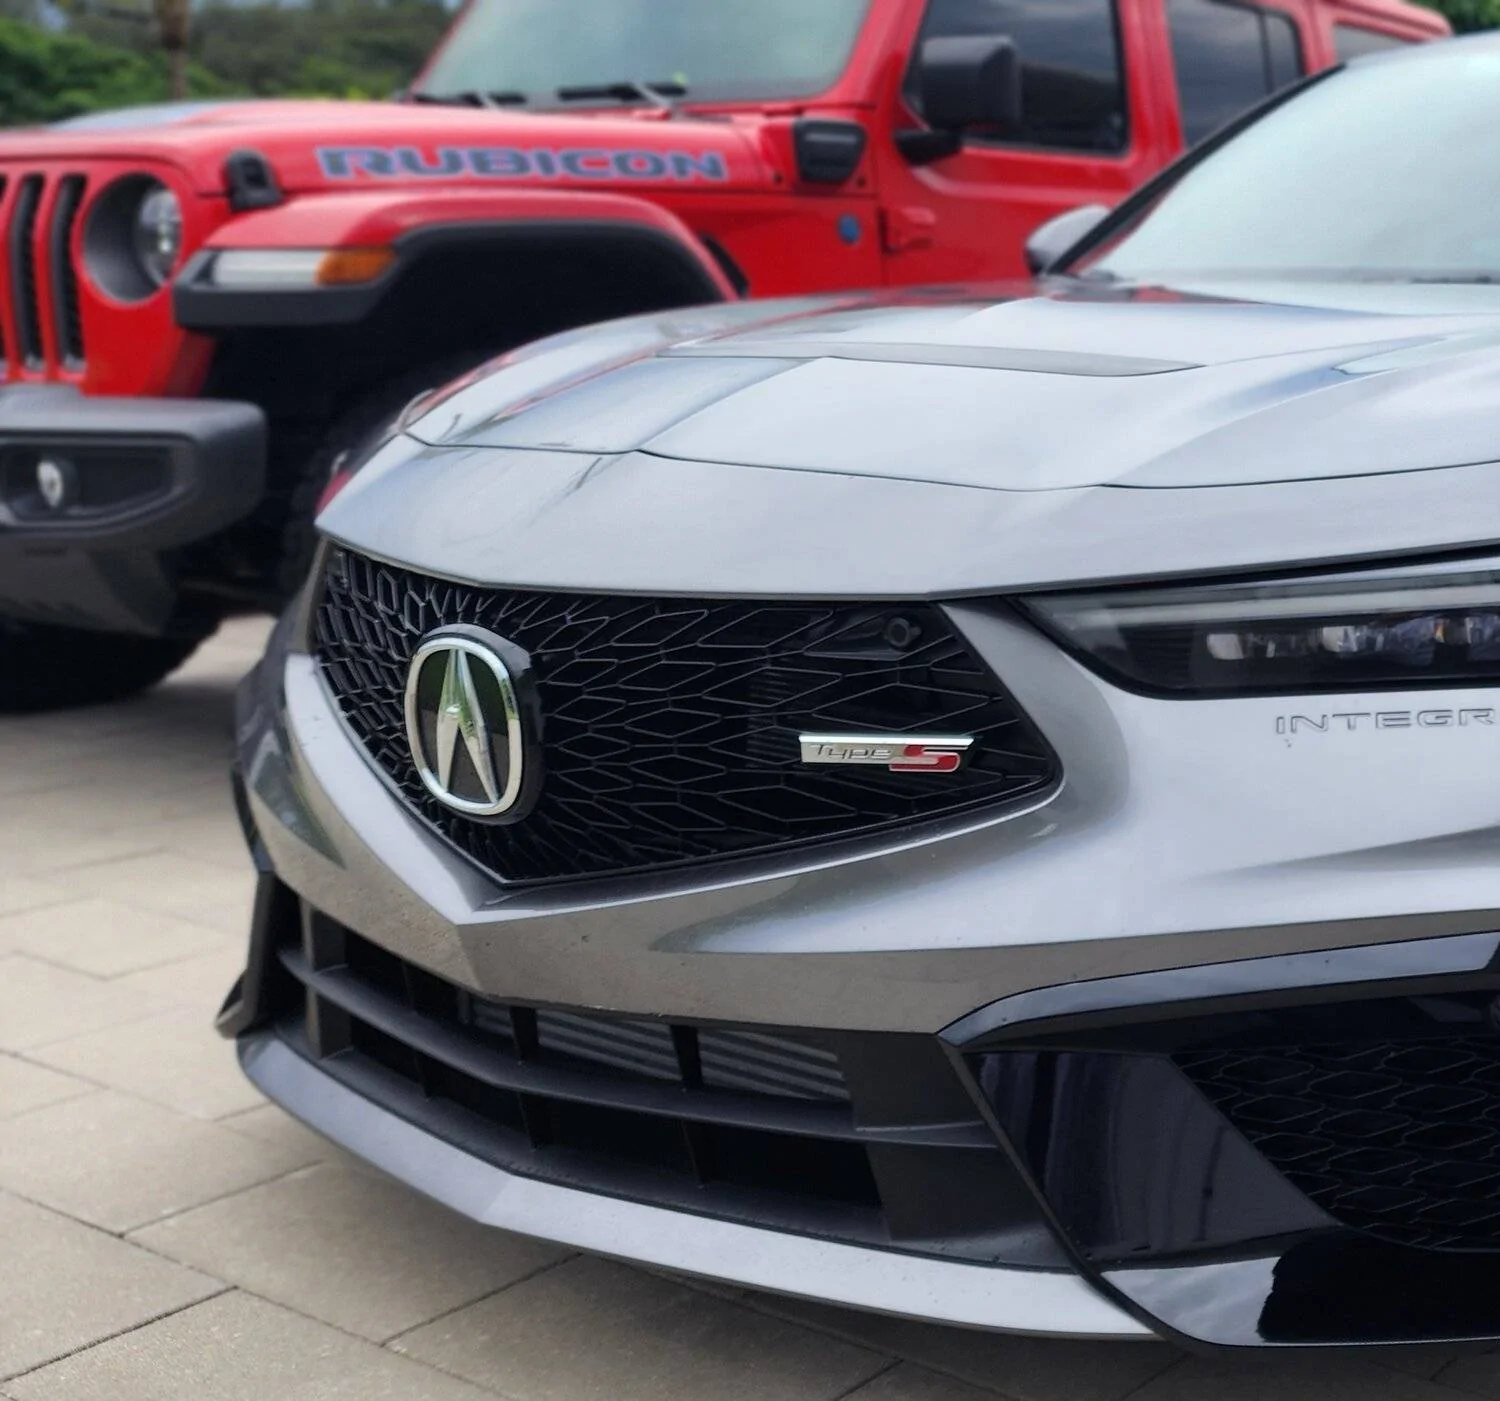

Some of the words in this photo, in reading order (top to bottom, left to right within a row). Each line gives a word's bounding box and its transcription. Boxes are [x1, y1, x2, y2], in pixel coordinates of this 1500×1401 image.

[315, 144, 728, 181] RUBICON
[809, 743, 891, 760] Type
[889, 743, 968, 772] S
